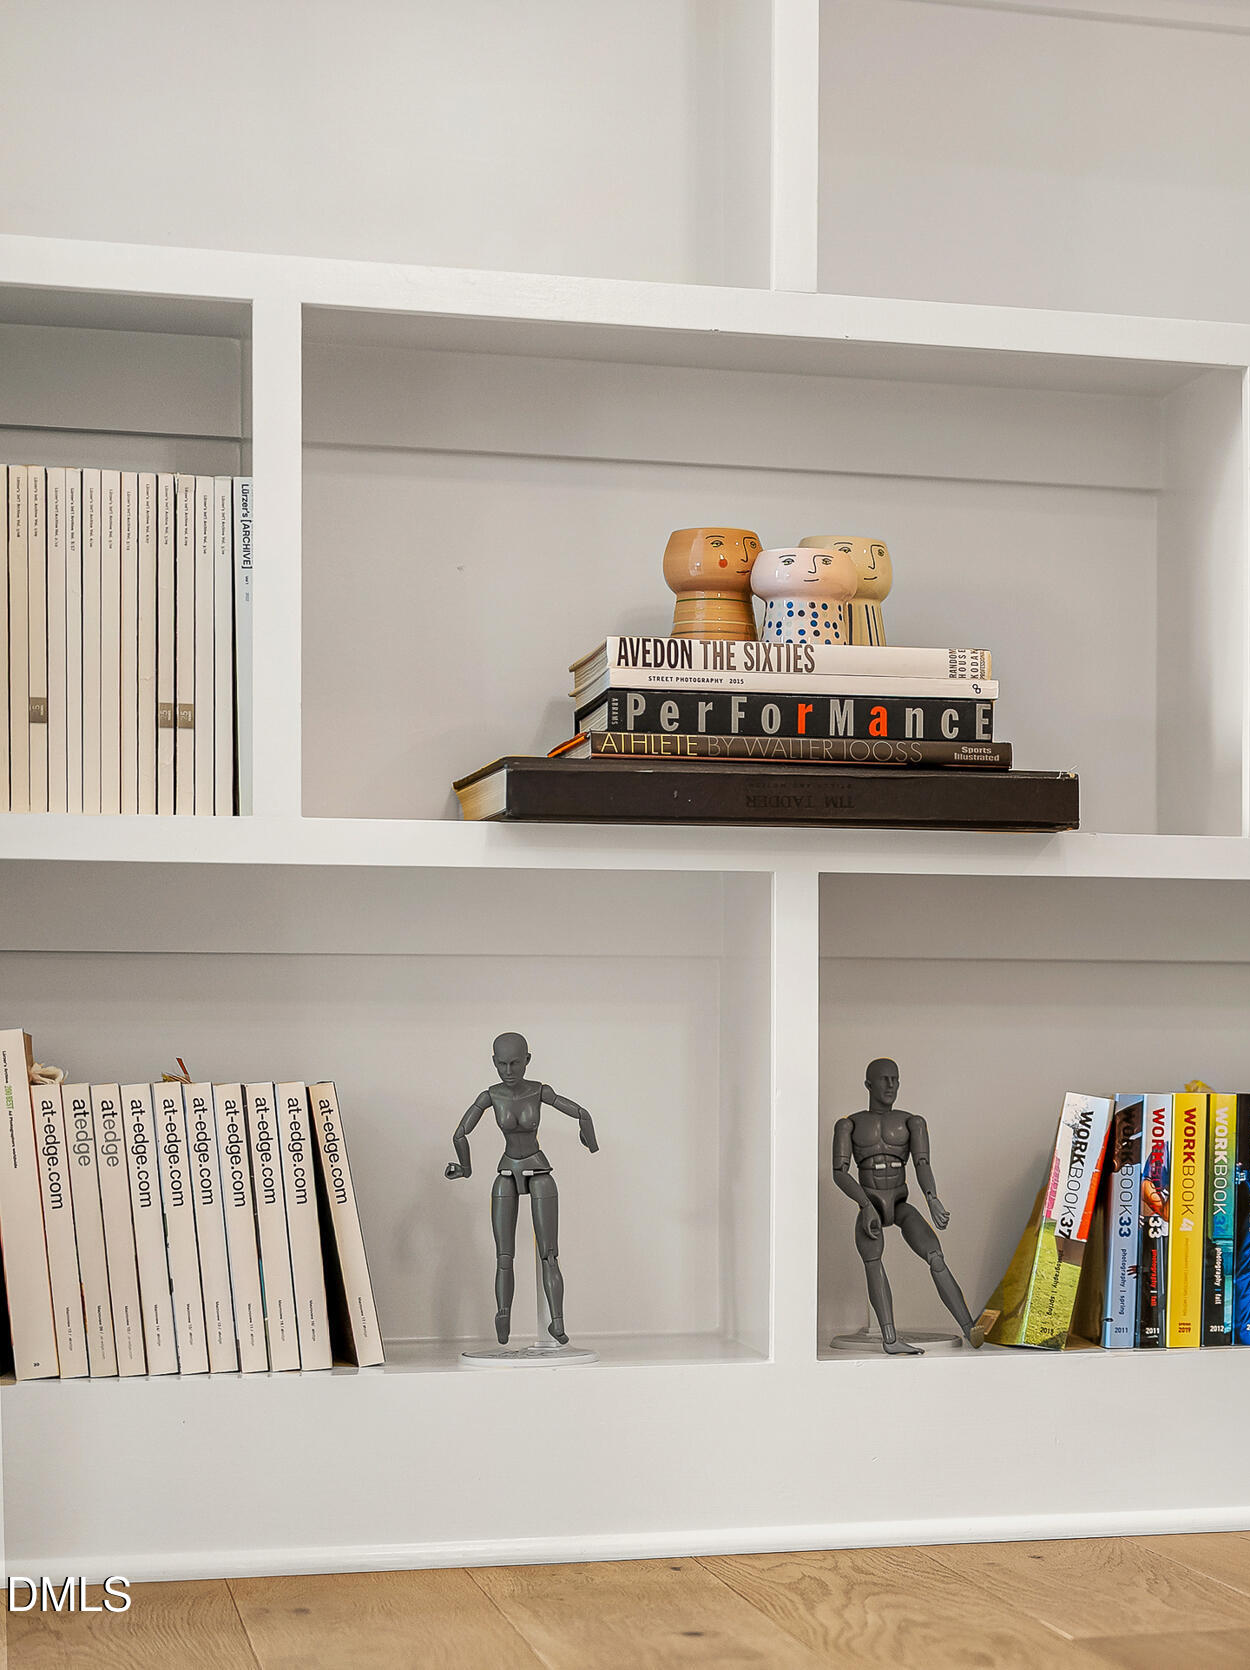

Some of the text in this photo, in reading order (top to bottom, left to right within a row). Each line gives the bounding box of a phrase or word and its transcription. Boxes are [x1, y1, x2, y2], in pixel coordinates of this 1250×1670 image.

[240, 484, 252, 570] Lürzer's [ARCHIVE]
[616, 637, 815, 673] AVEDON THE SIXTIES
[949, 649, 957, 678] RANDOM
[958, 649, 966, 678] HOUSE
[601, 732, 922, 762] ATHLETE BY WALTER IOOSS
[954, 752, 999, 761] Illustrated
[41, 1100, 63, 1209] at-edge.com
[130, 1100, 152, 1208] at-edge.com
[163, 1099, 184, 1207] at-edge.com
[193, 1098, 214, 1205] at-edge.com
[225, 1100, 246, 1207] at-edge.com
[255, 1098, 276, 1204] at-edge.com
[288, 1098, 308, 1204] at-edge.com
[319, 1099, 348, 1204] at-edge.com
[1058, 1111, 1094, 1239] WORKBOOK37
[1214, 1248, 1222, 1286] photography
